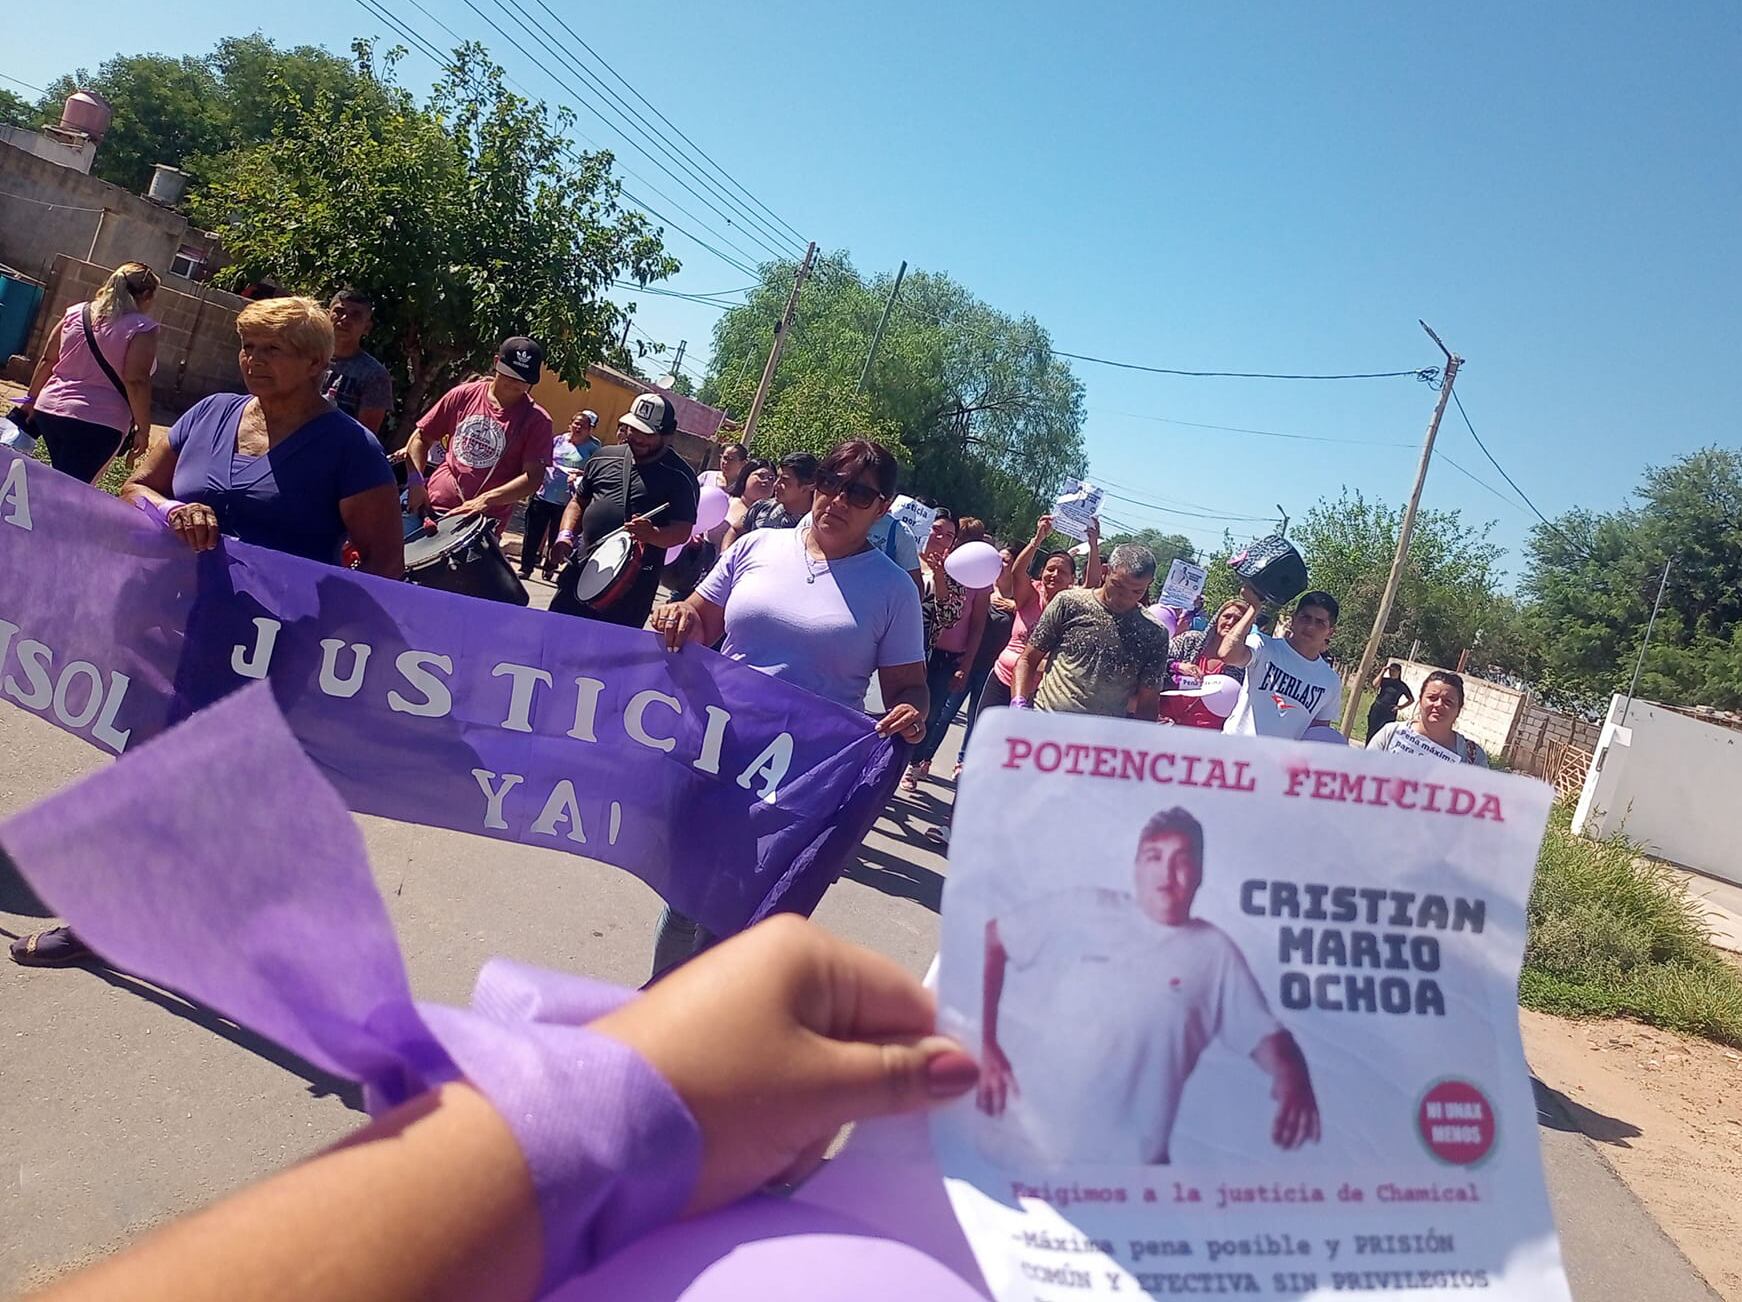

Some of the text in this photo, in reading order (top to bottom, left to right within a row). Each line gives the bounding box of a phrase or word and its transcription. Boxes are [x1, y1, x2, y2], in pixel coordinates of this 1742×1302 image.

[231, 617, 794, 804] JUSTICIA
[1258, 661, 1326, 714] EVERLAST
[1395, 740, 1415, 755] para
[1002, 737, 1505, 822] POTENCIAL FEMICIDA
[1240, 879, 1486, 934] CRISTIAN
[1278, 926, 1441, 973] MARIO
[1280, 971, 1446, 1017] OCHOA
[1432, 1124, 1480, 1144] MENOS
[1011, 1181, 1480, 1209] Exigimos a la justicia de Chamical
[1129, 1238, 1193, 1261] pena
[1206, 1233, 1312, 1262] posible
[1325, 1239, 1340, 1261] y
[1354, 1226, 1455, 1254] PRISIÓN
[1106, 1272, 1122, 1291] Y
[1137, 1272, 1260, 1293] EFECTIVA
[1272, 1271, 1318, 1293] SIN
[1331, 1268, 1490, 1291] PRIVILEGIOS
